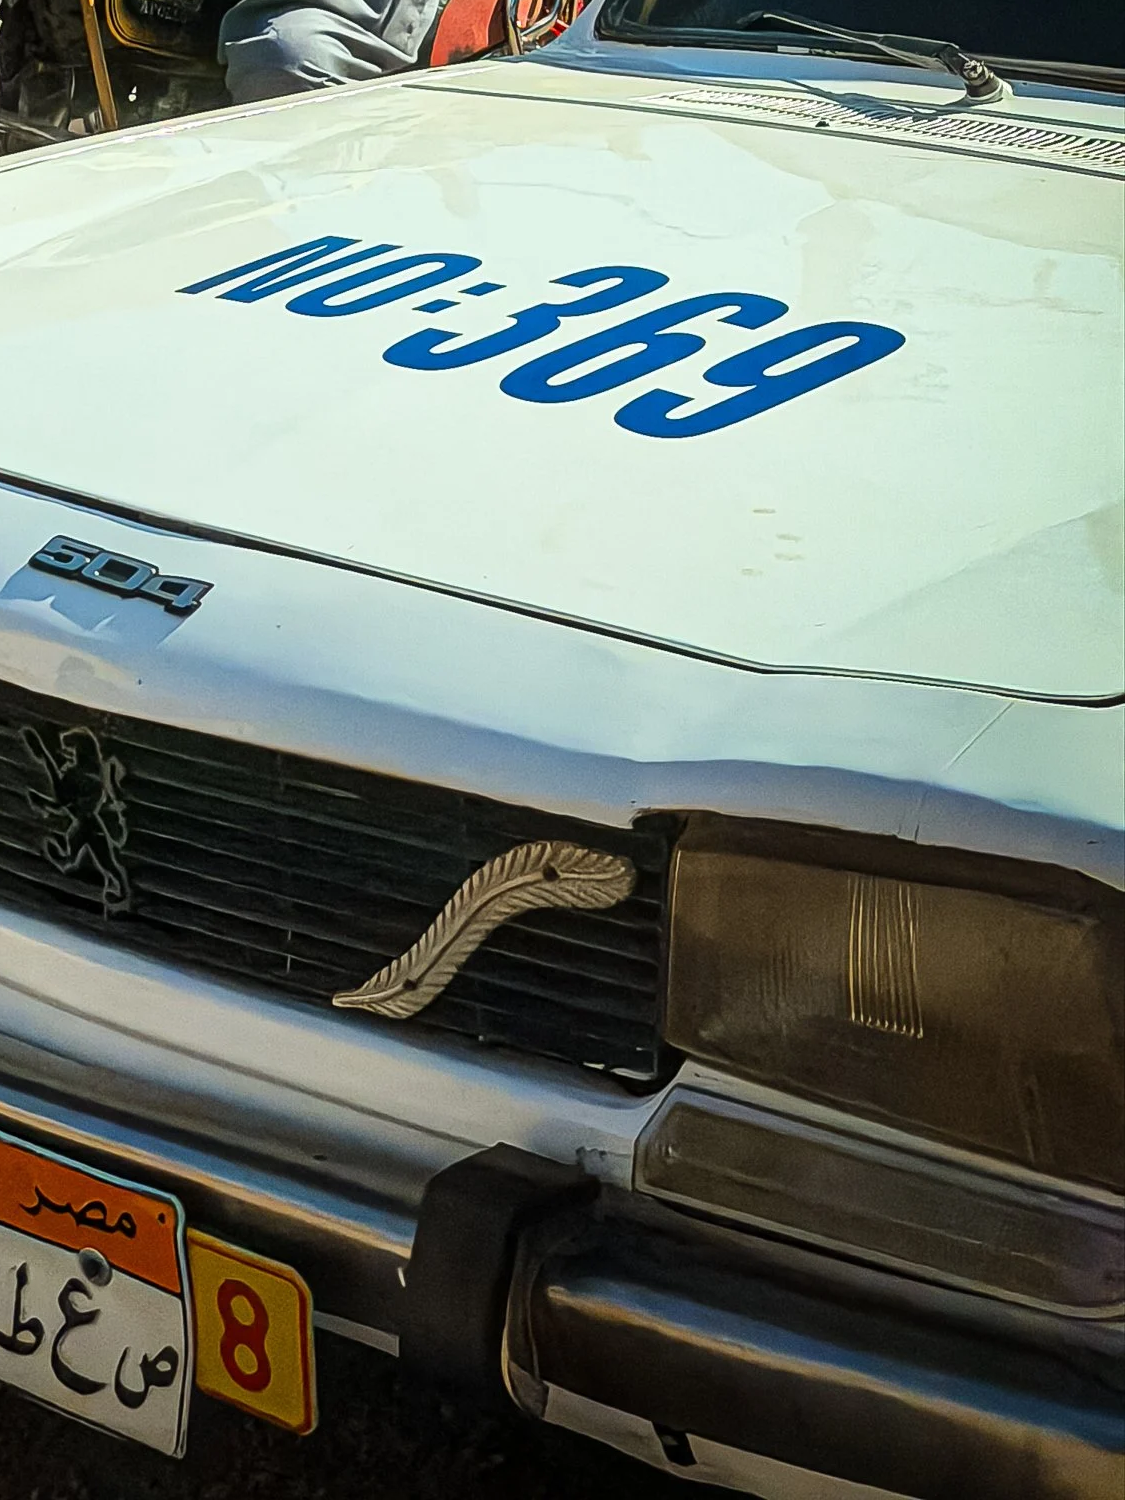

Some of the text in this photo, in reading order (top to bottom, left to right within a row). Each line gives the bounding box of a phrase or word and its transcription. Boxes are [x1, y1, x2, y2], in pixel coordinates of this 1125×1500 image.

[28, 534, 215, 617] 504
[19, 1186, 138, 1239] مصر
[216, 1278, 272, 1393] 8
